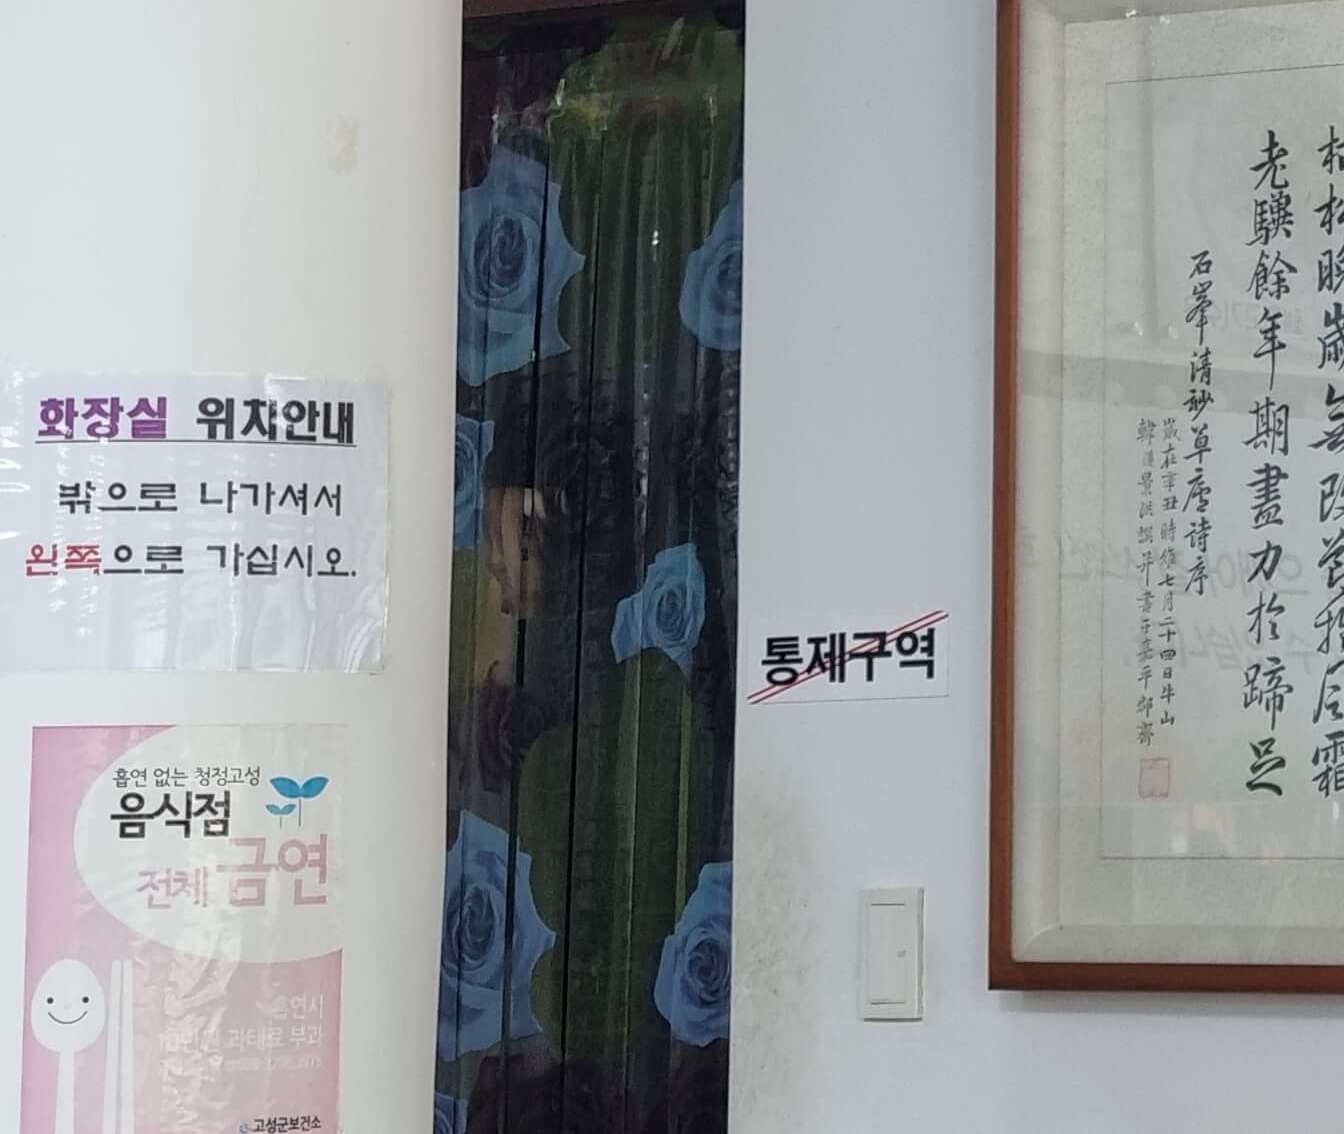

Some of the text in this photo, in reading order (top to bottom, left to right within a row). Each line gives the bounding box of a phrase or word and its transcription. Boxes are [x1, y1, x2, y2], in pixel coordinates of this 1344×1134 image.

[38, 397, 354, 444] 화장실 위치안내
[58, 481, 341, 516] 밖으로 나가셔서
[25, 543, 356, 577] 왼쪽으로 가십시오.
[761, 627, 935, 686] 통제구역
[112, 766, 261, 787] 흡연 없는 청정고성
[110, 790, 231, 839] 음식점
[136, 833, 328, 909] 전체 금연
[290, 1024, 322, 1049] 부과
[253, 1115, 322, 1133] 고성군보건소
